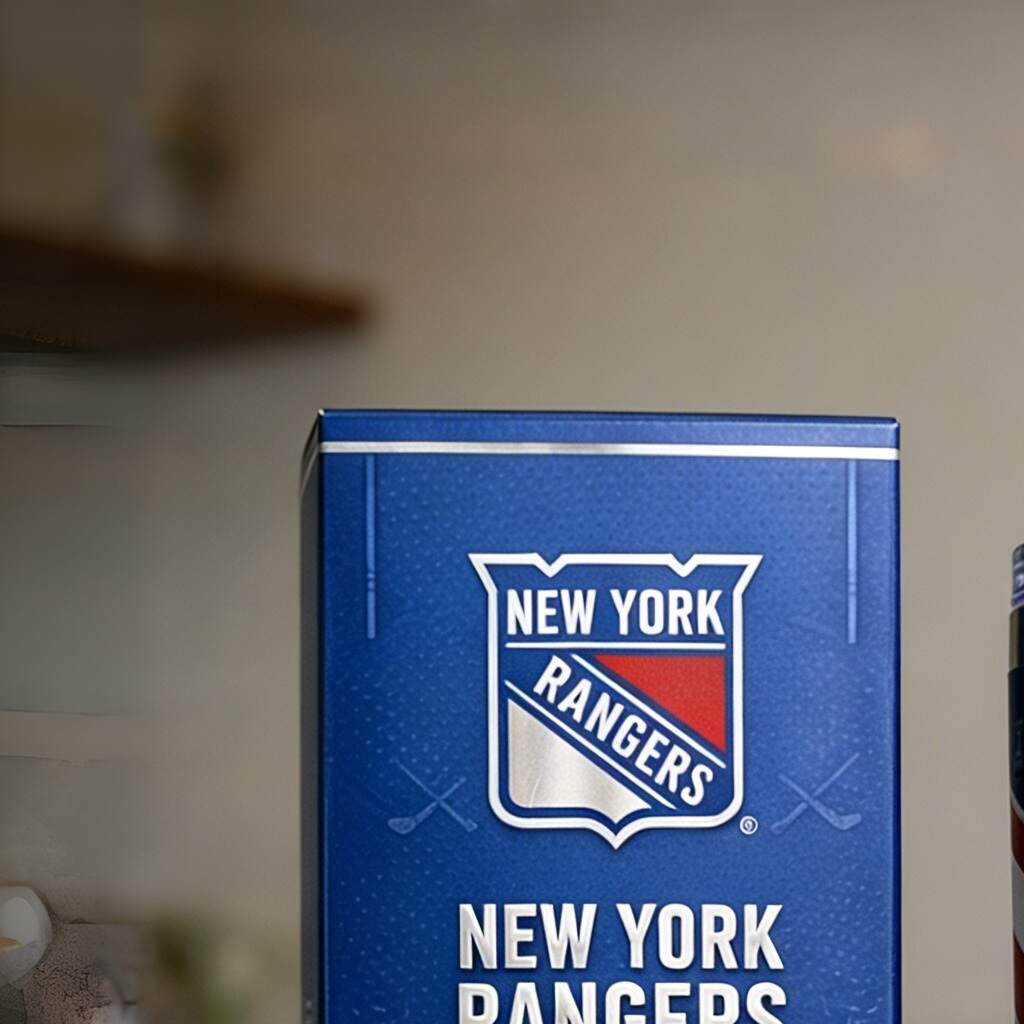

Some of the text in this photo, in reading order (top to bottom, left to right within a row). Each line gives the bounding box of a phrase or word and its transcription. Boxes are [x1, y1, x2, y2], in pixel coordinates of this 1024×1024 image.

[507, 588, 725, 636] NEW YORK
[533, 655, 714, 807] RANGERS
[459, 902, 784, 970] NEW YORK
